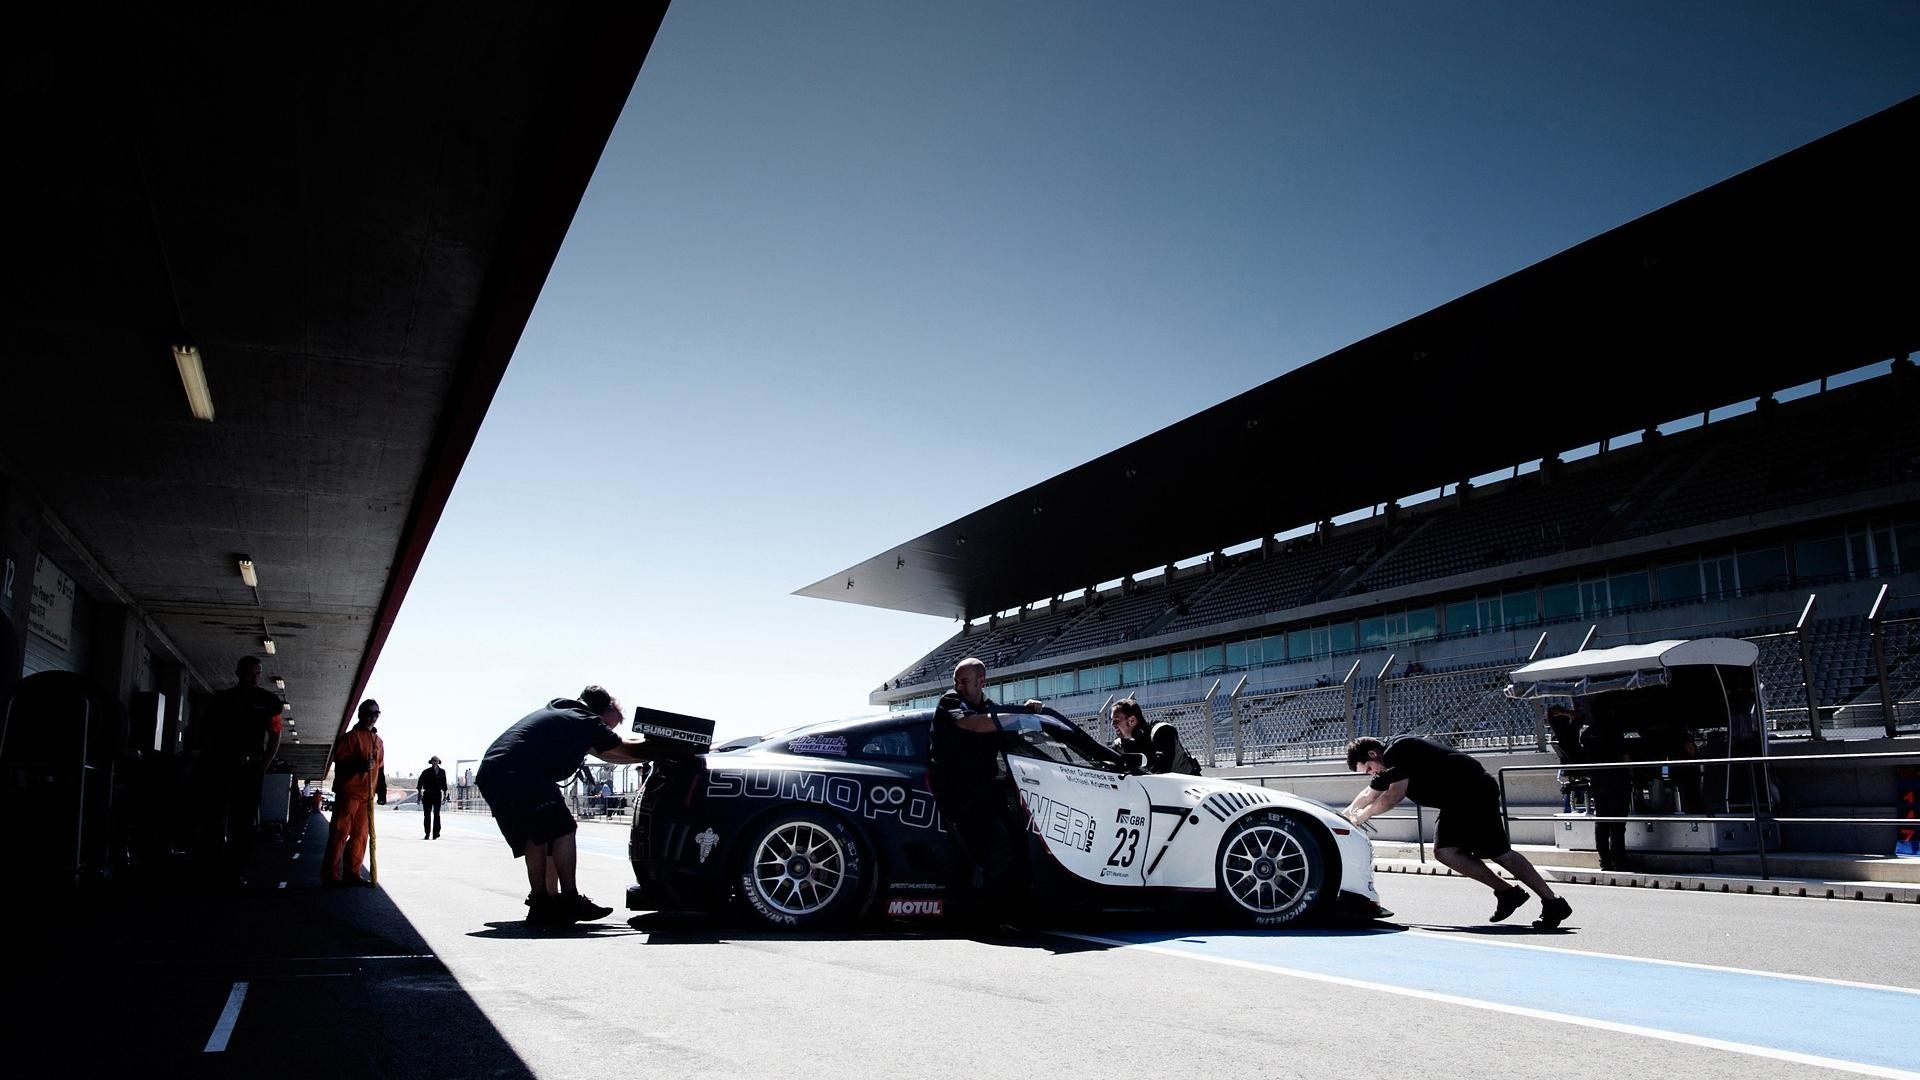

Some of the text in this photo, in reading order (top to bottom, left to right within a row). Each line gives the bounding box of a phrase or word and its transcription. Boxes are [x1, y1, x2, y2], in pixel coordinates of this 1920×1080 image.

[4, 557, 16, 600] 12
[1129, 815, 1146, 827] GBR
[1106, 827, 1141, 868] 23
[743, 875, 785, 923] MICHELIN
[888, 901, 941, 914] MOTUL
[1255, 901, 1308, 926] MICHELIN
